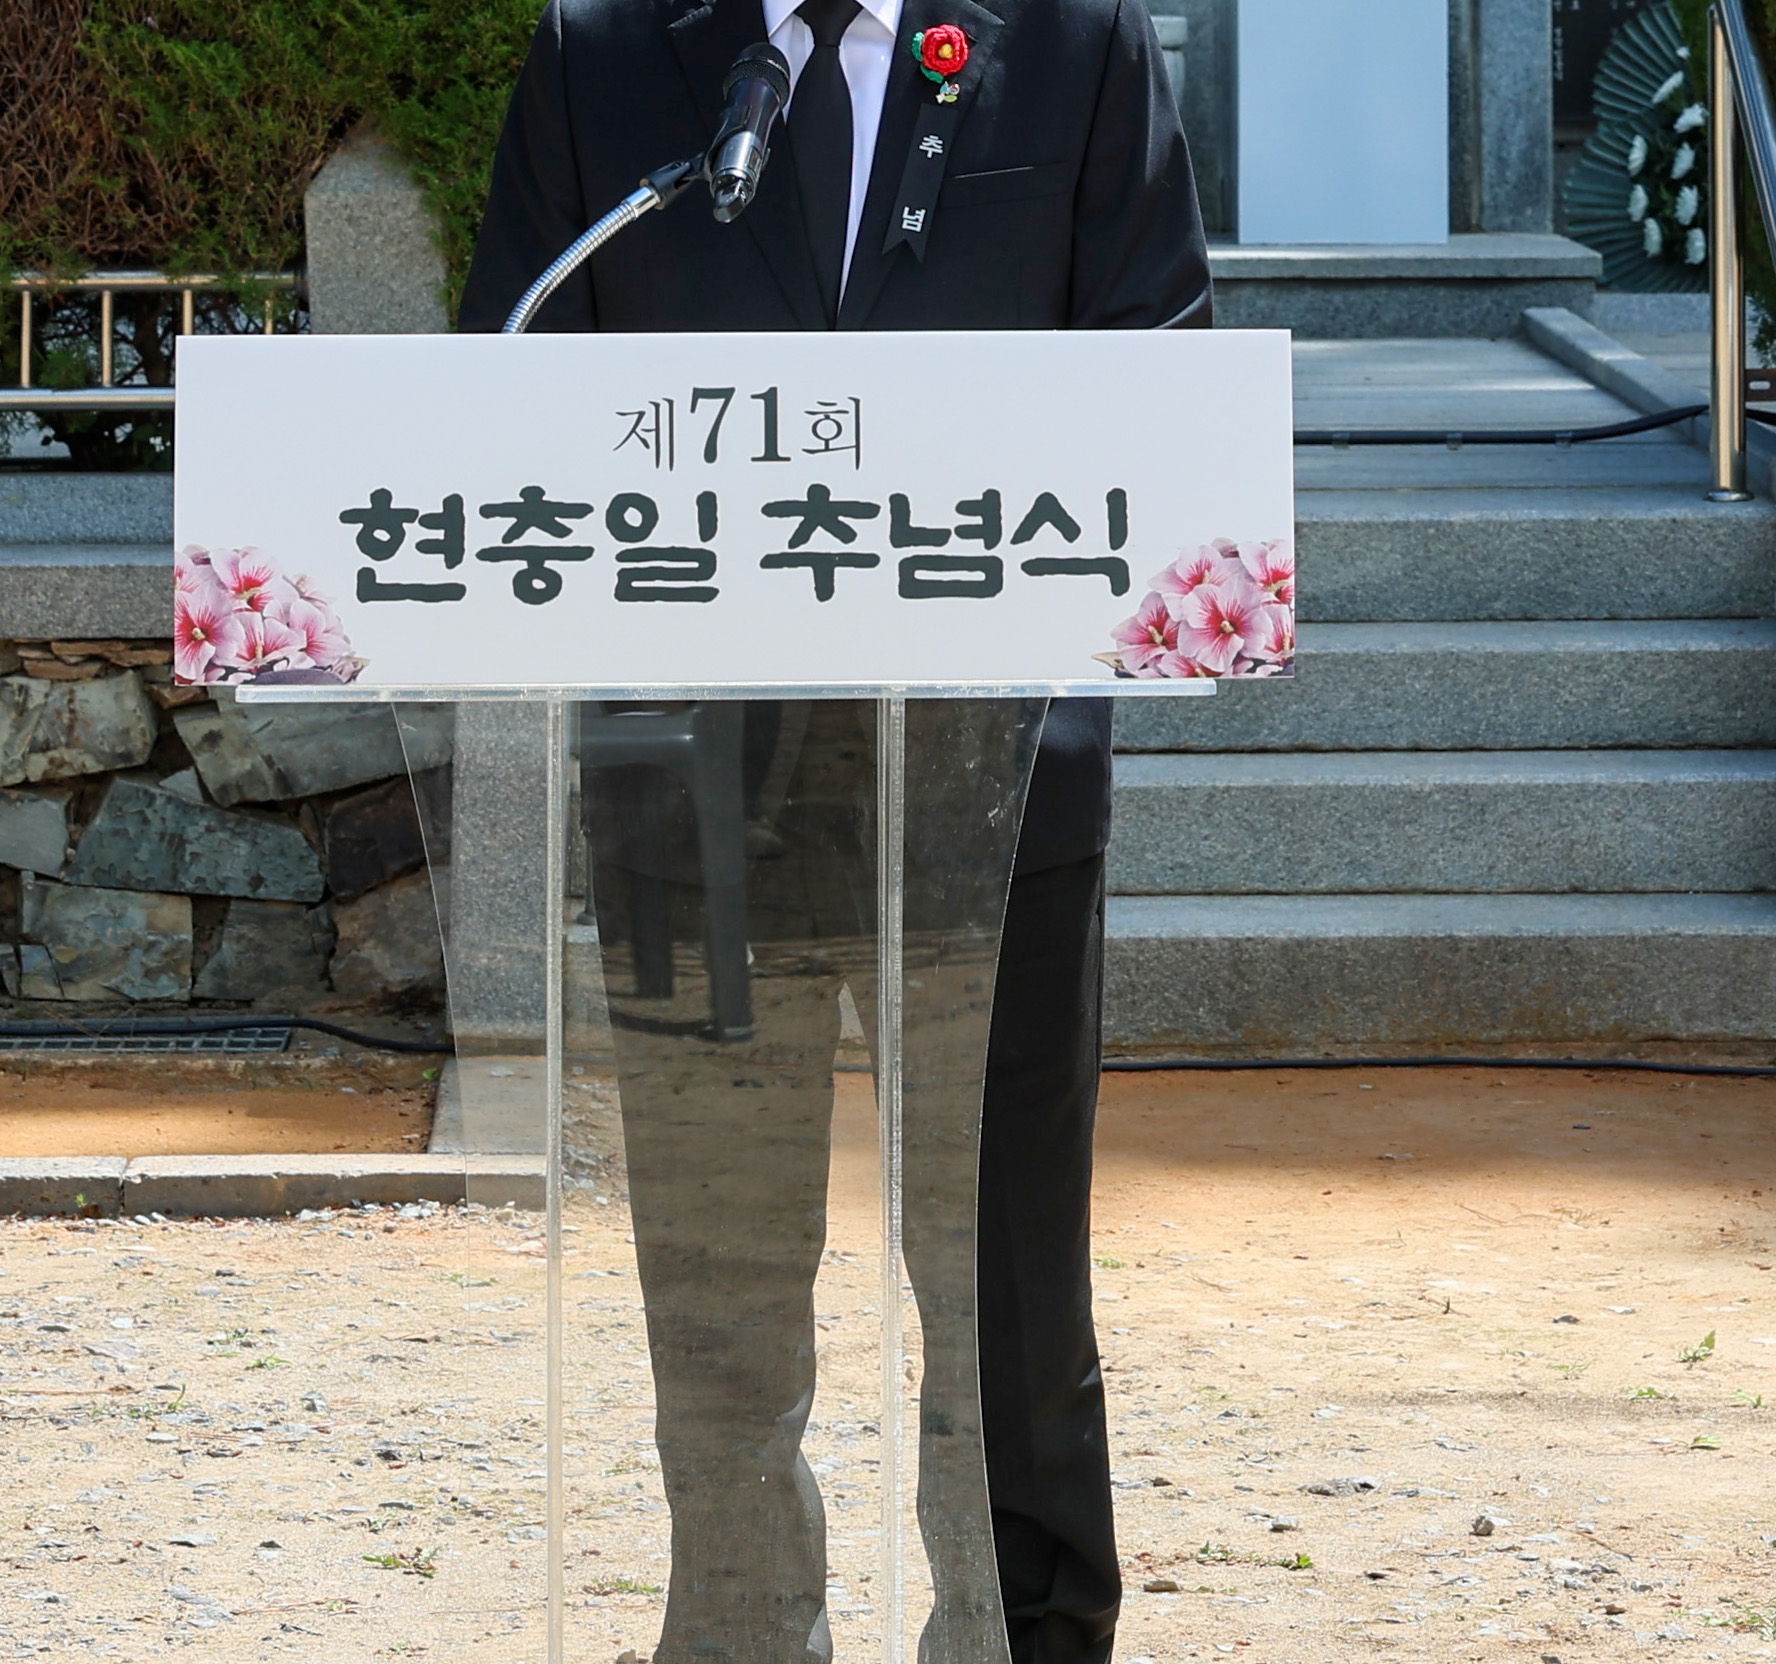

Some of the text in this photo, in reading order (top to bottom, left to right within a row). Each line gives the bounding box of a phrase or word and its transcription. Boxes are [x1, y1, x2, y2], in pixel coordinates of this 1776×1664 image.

[613, 386, 862, 472] 제71회
[339, 483, 1131, 606] 현충일 추념식
